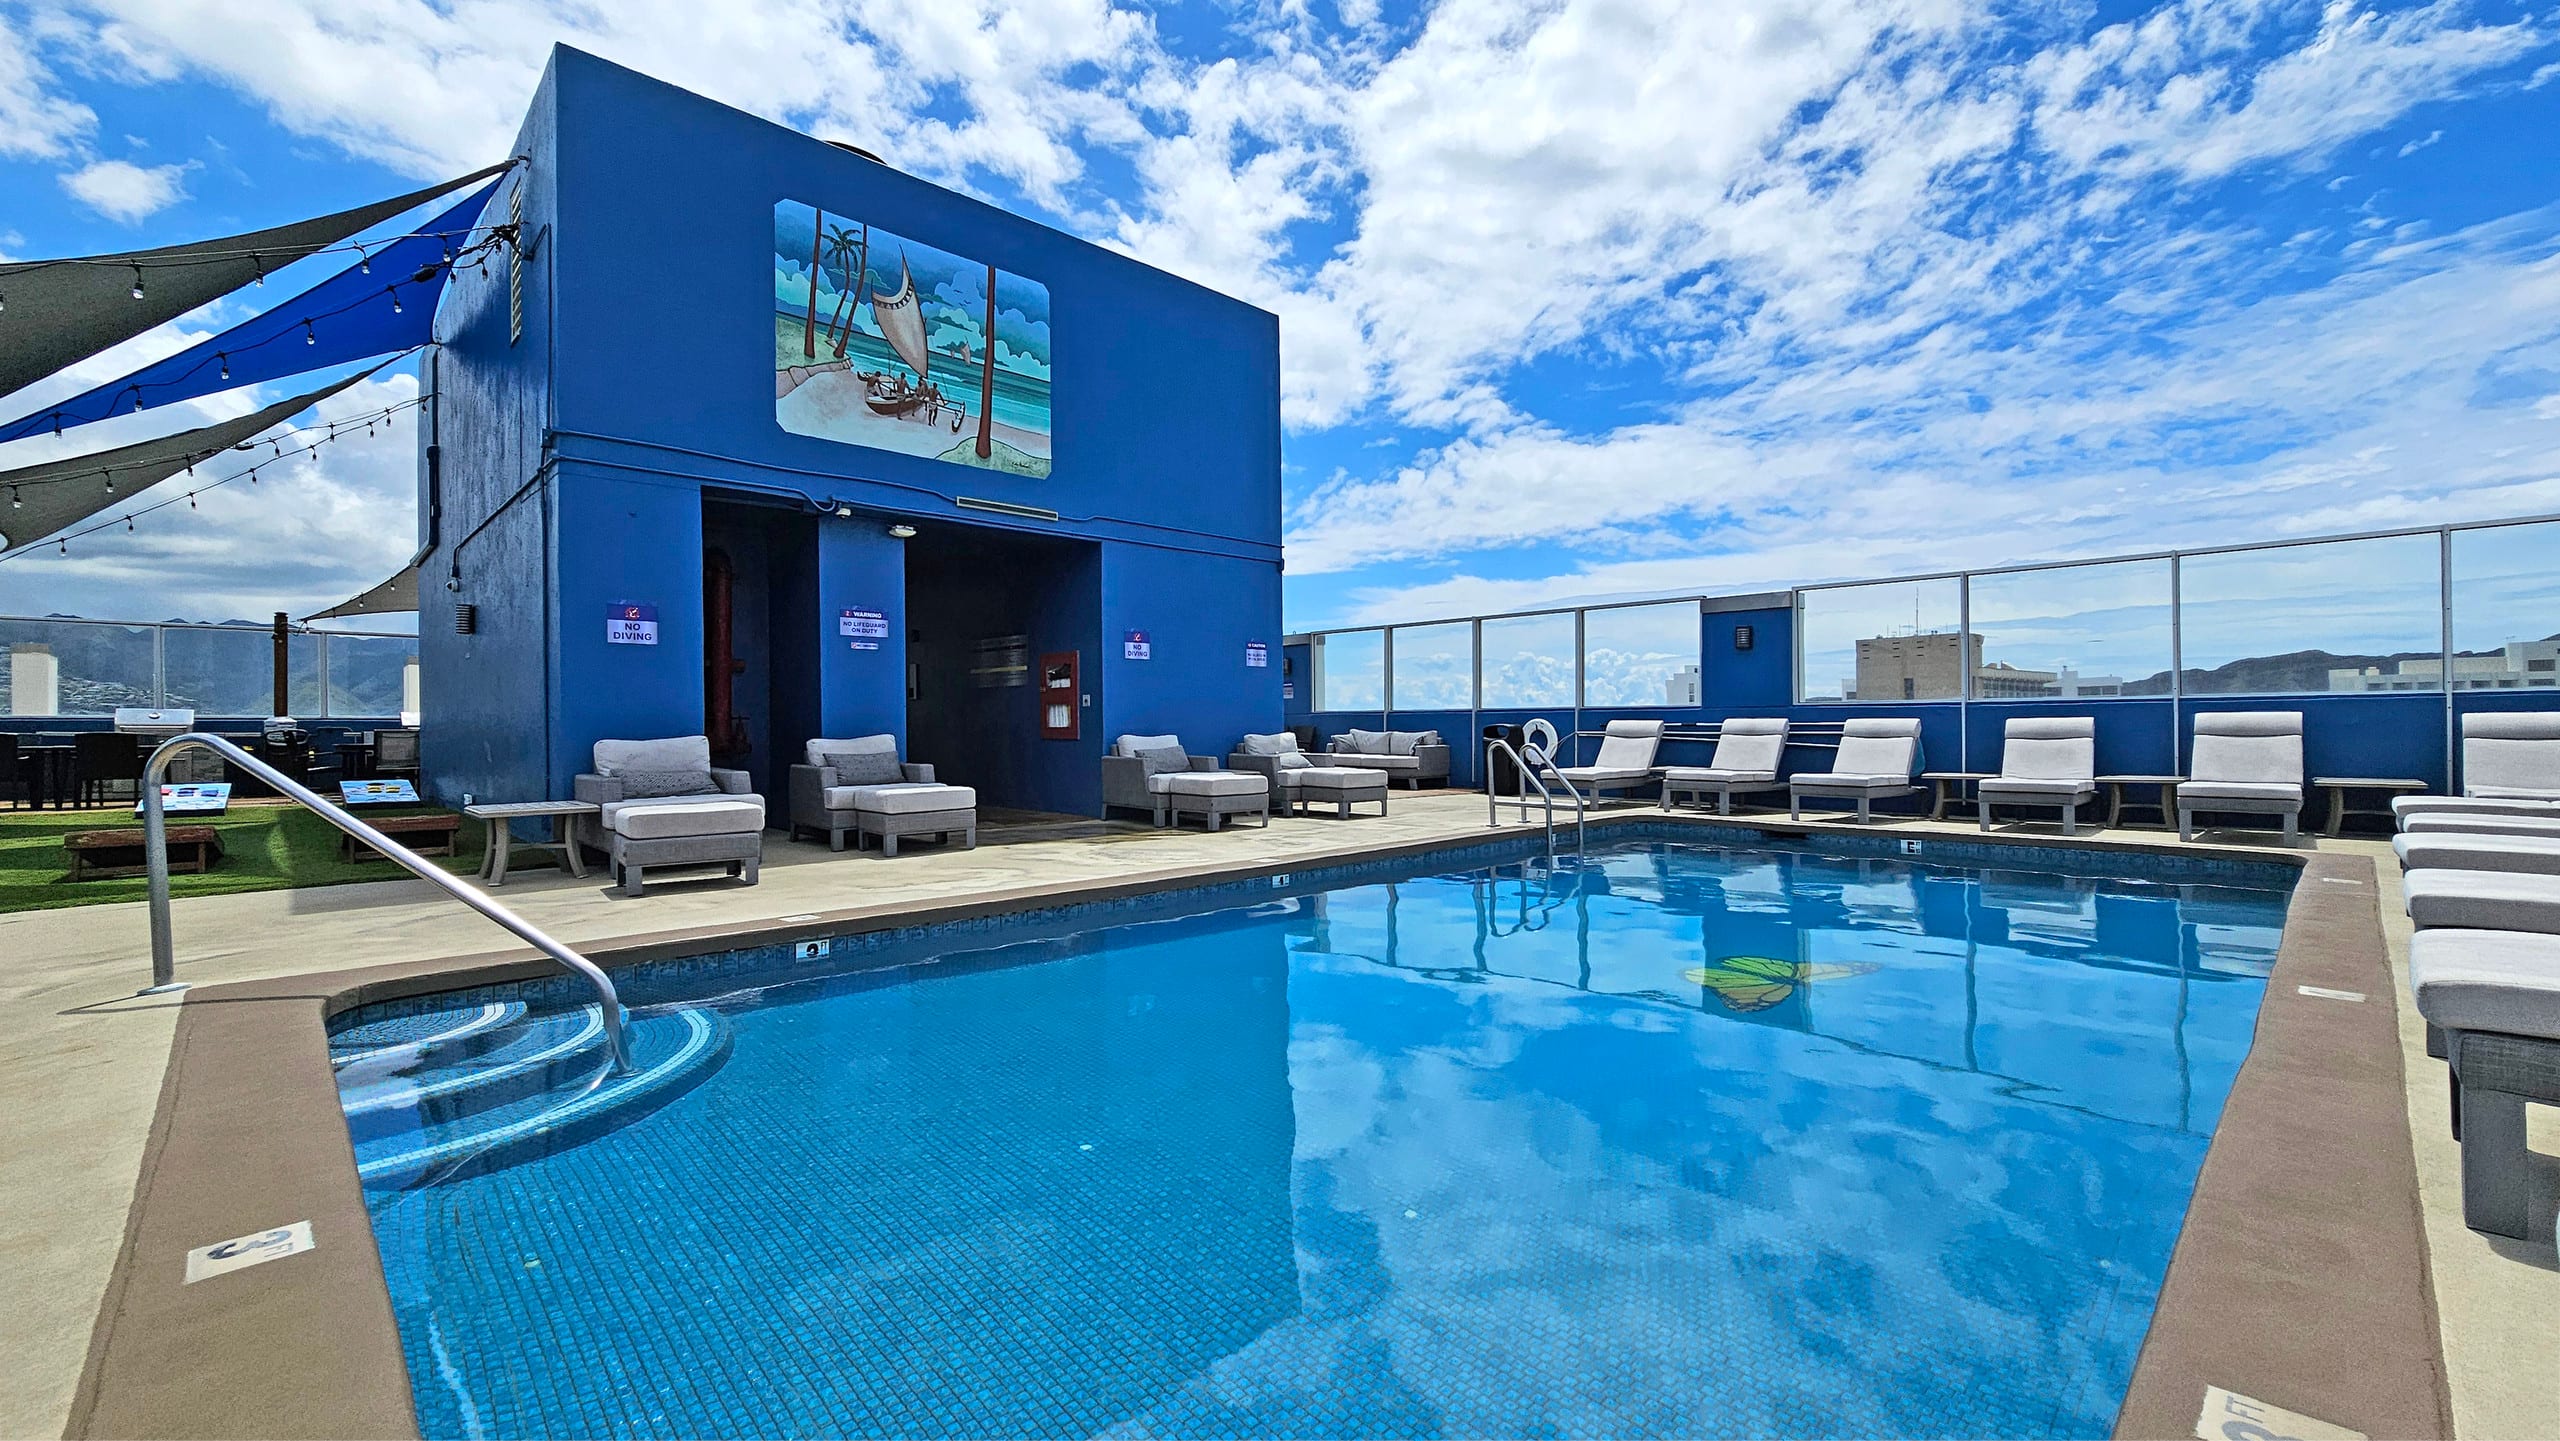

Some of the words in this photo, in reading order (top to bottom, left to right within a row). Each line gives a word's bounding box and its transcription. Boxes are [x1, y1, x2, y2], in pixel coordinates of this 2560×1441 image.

[613, 631, 652, 641] DIVING
[624, 622, 641, 631] NO
[207, 1230, 293, 1260] 3
[2225, 1395, 2265, 1424] FT
